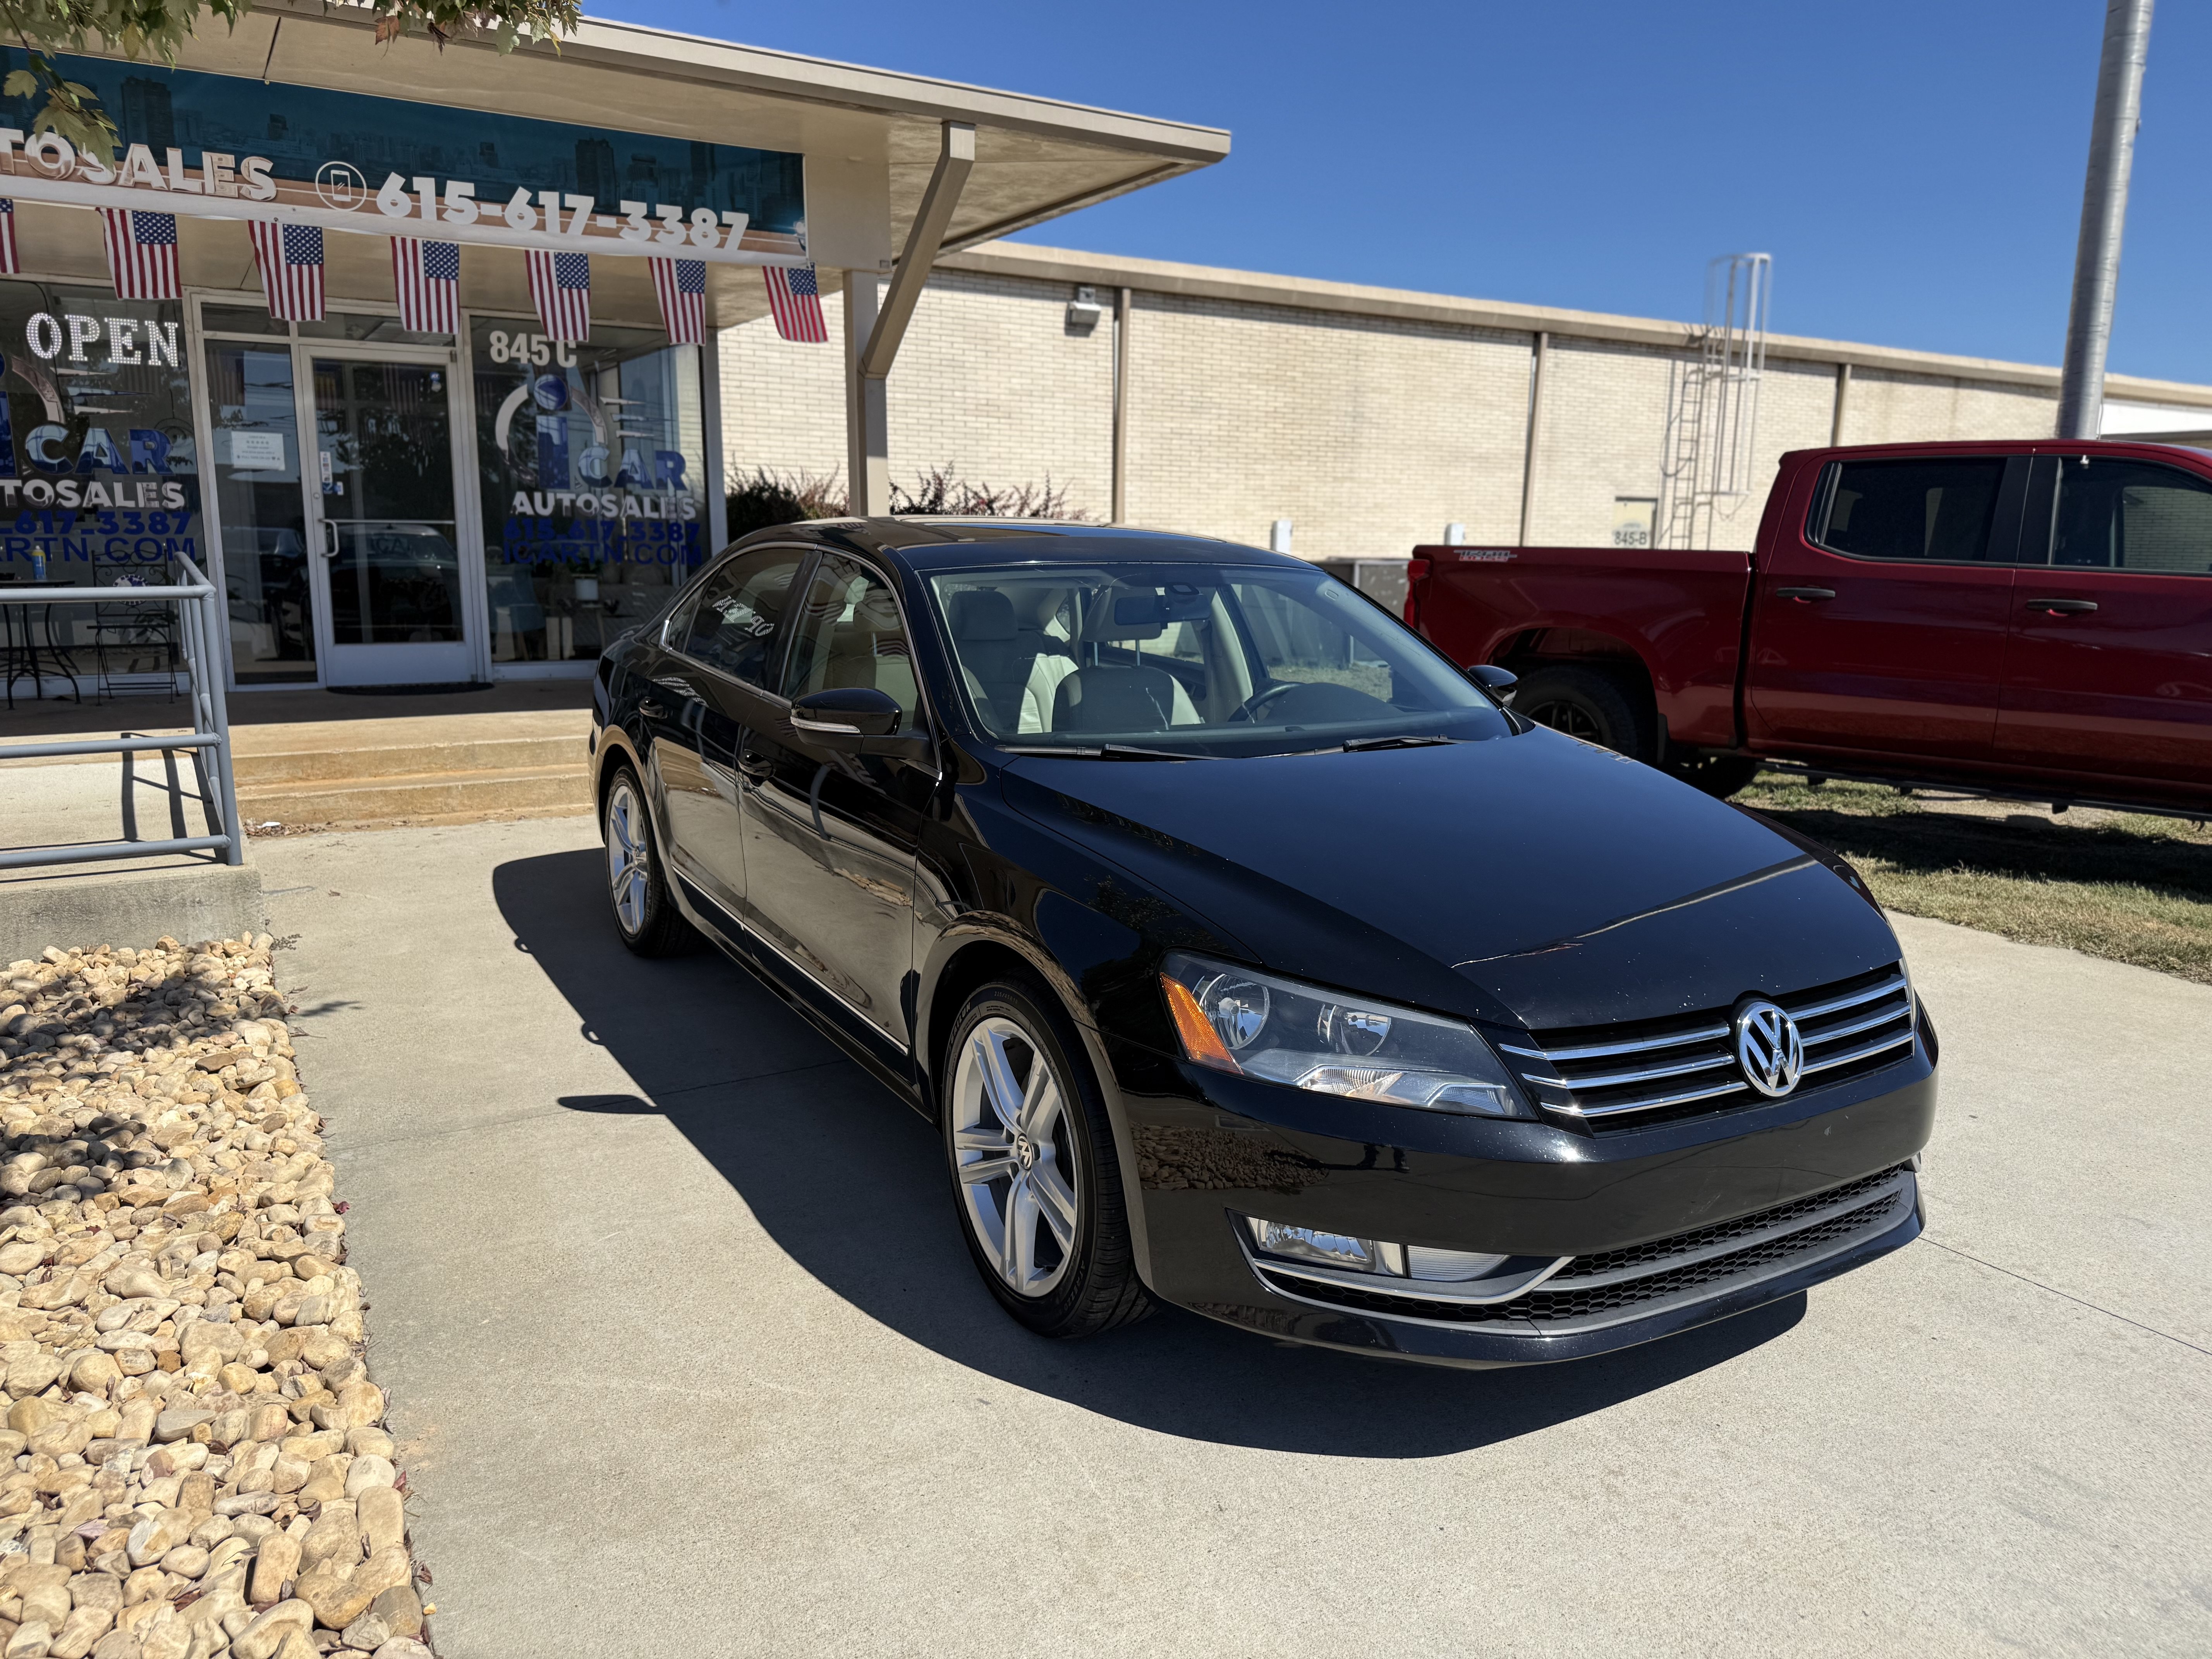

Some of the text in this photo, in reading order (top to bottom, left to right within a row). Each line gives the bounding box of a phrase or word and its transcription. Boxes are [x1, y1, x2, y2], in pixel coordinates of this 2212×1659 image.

[376, 172, 749, 251] 615-617-3387
[26, 312, 179, 367] OPEN
[489, 330, 577, 368] 845 C
[511, 491, 696, 520] AUTOSALES
[0, 537, 196, 562] RTN.COM
[504, 541, 702, 565] ICARTN.COM
